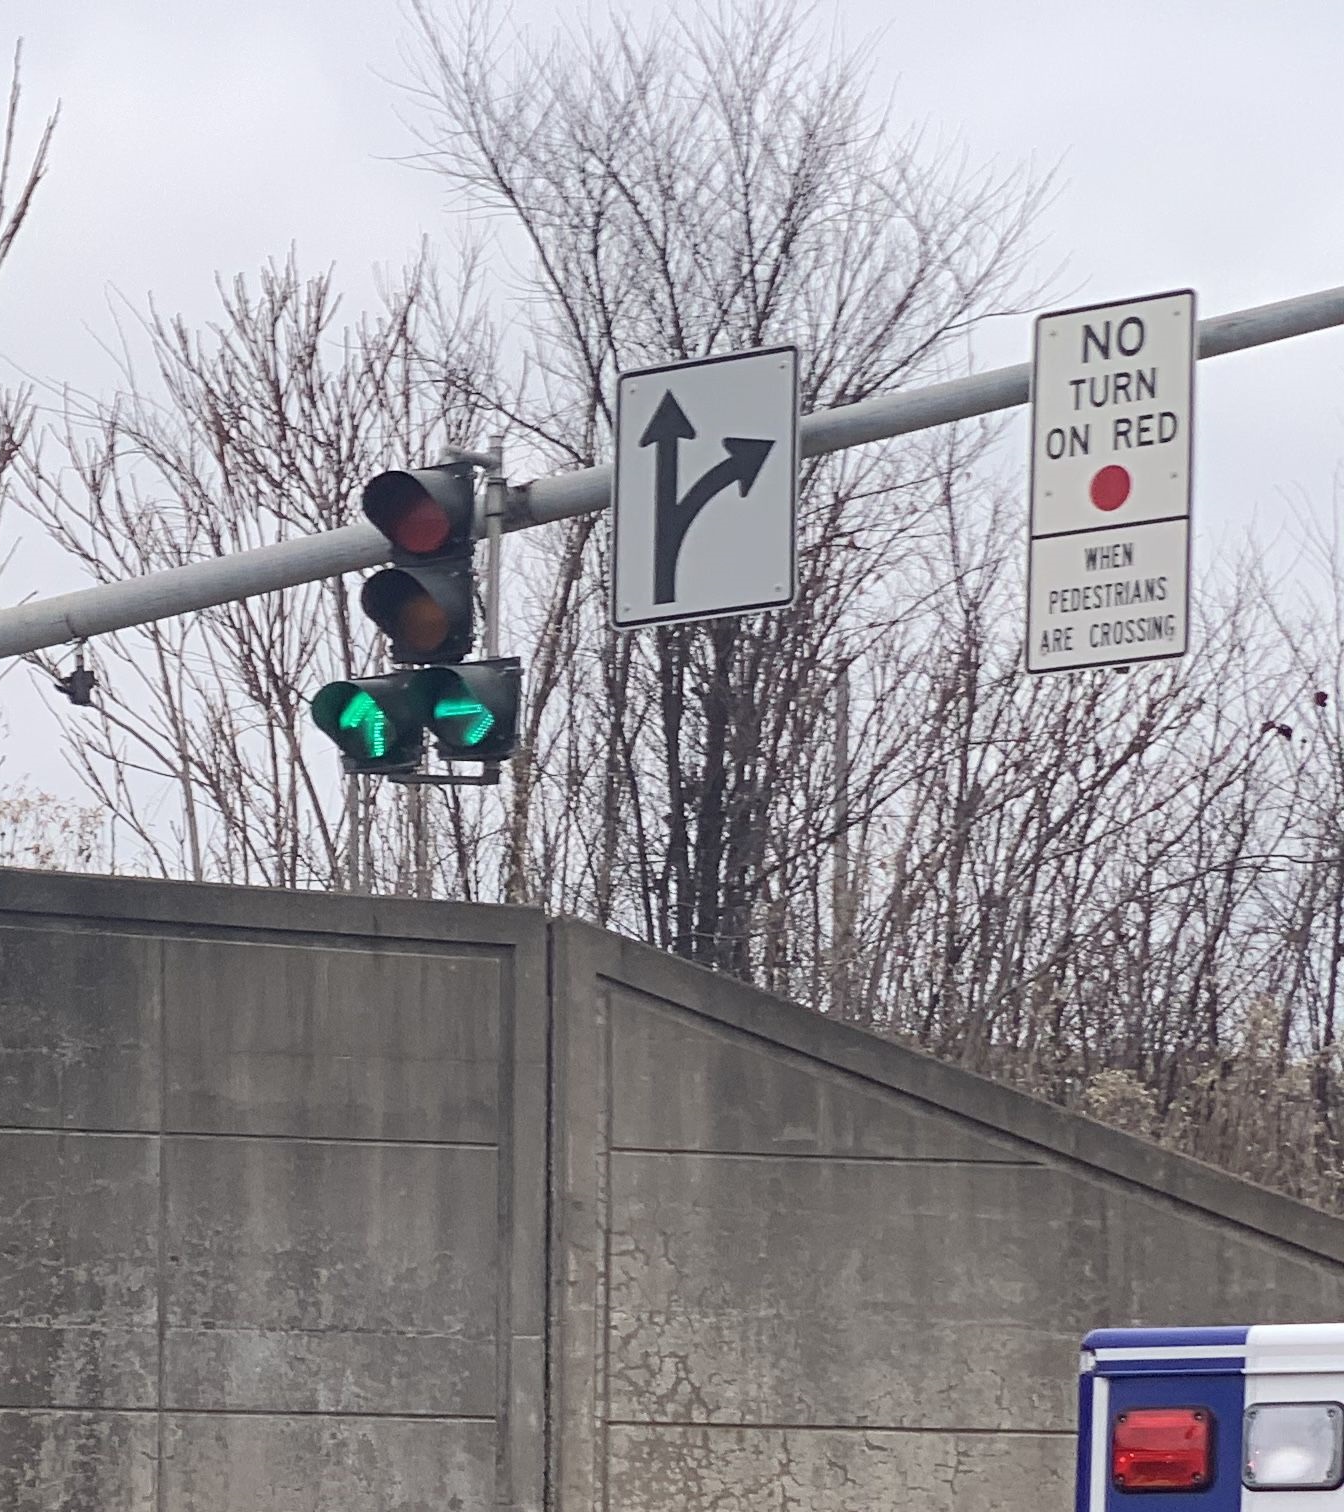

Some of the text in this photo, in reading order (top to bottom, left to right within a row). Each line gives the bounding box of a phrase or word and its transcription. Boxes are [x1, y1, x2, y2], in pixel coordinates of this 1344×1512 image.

[1081, 316, 1145, 364] NO
[1069, 367, 1157, 412] TURN
[1046, 411, 1178, 460] ON RED
[1083, 542, 1134, 572] WHEN
[1049, 576, 1167, 615] PEDESTRIANS
[1040, 614, 1176, 654] ARE CROSSING
